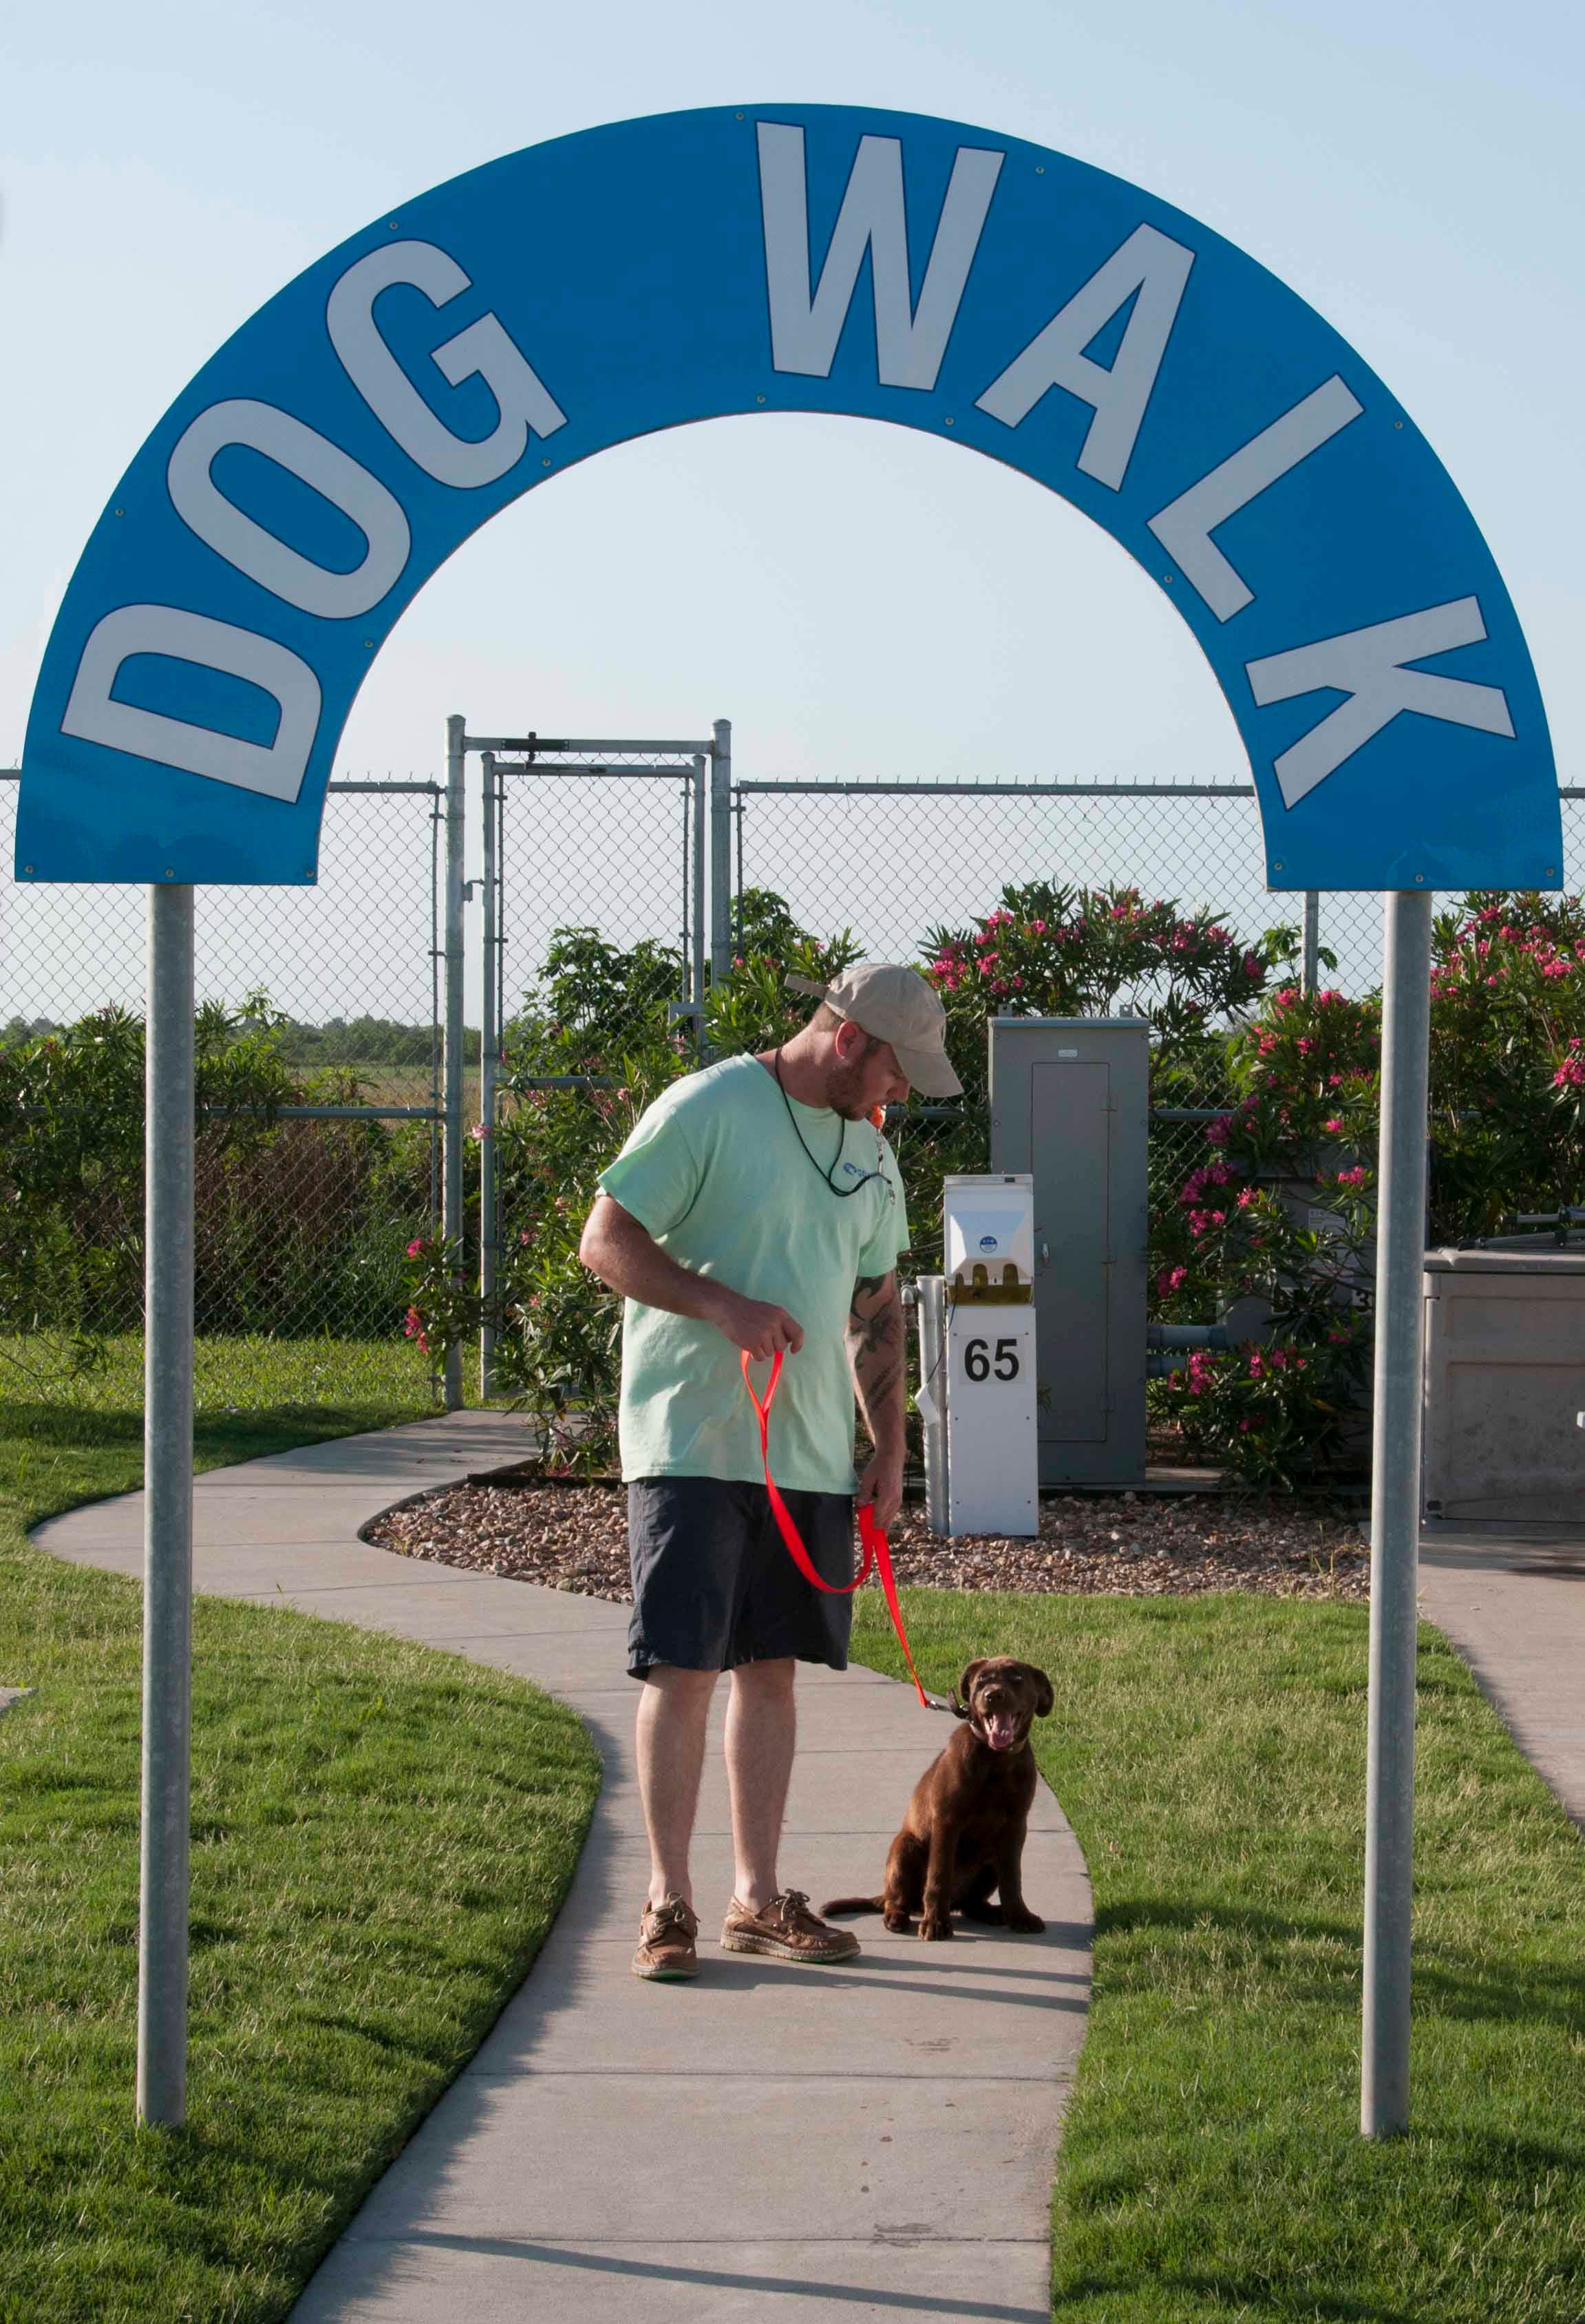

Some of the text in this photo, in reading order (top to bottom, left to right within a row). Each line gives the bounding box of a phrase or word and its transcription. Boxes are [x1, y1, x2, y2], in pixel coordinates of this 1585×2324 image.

[61, 122, 1515, 809] DOG WALK
[964, 1338, 1019, 1382] 65
